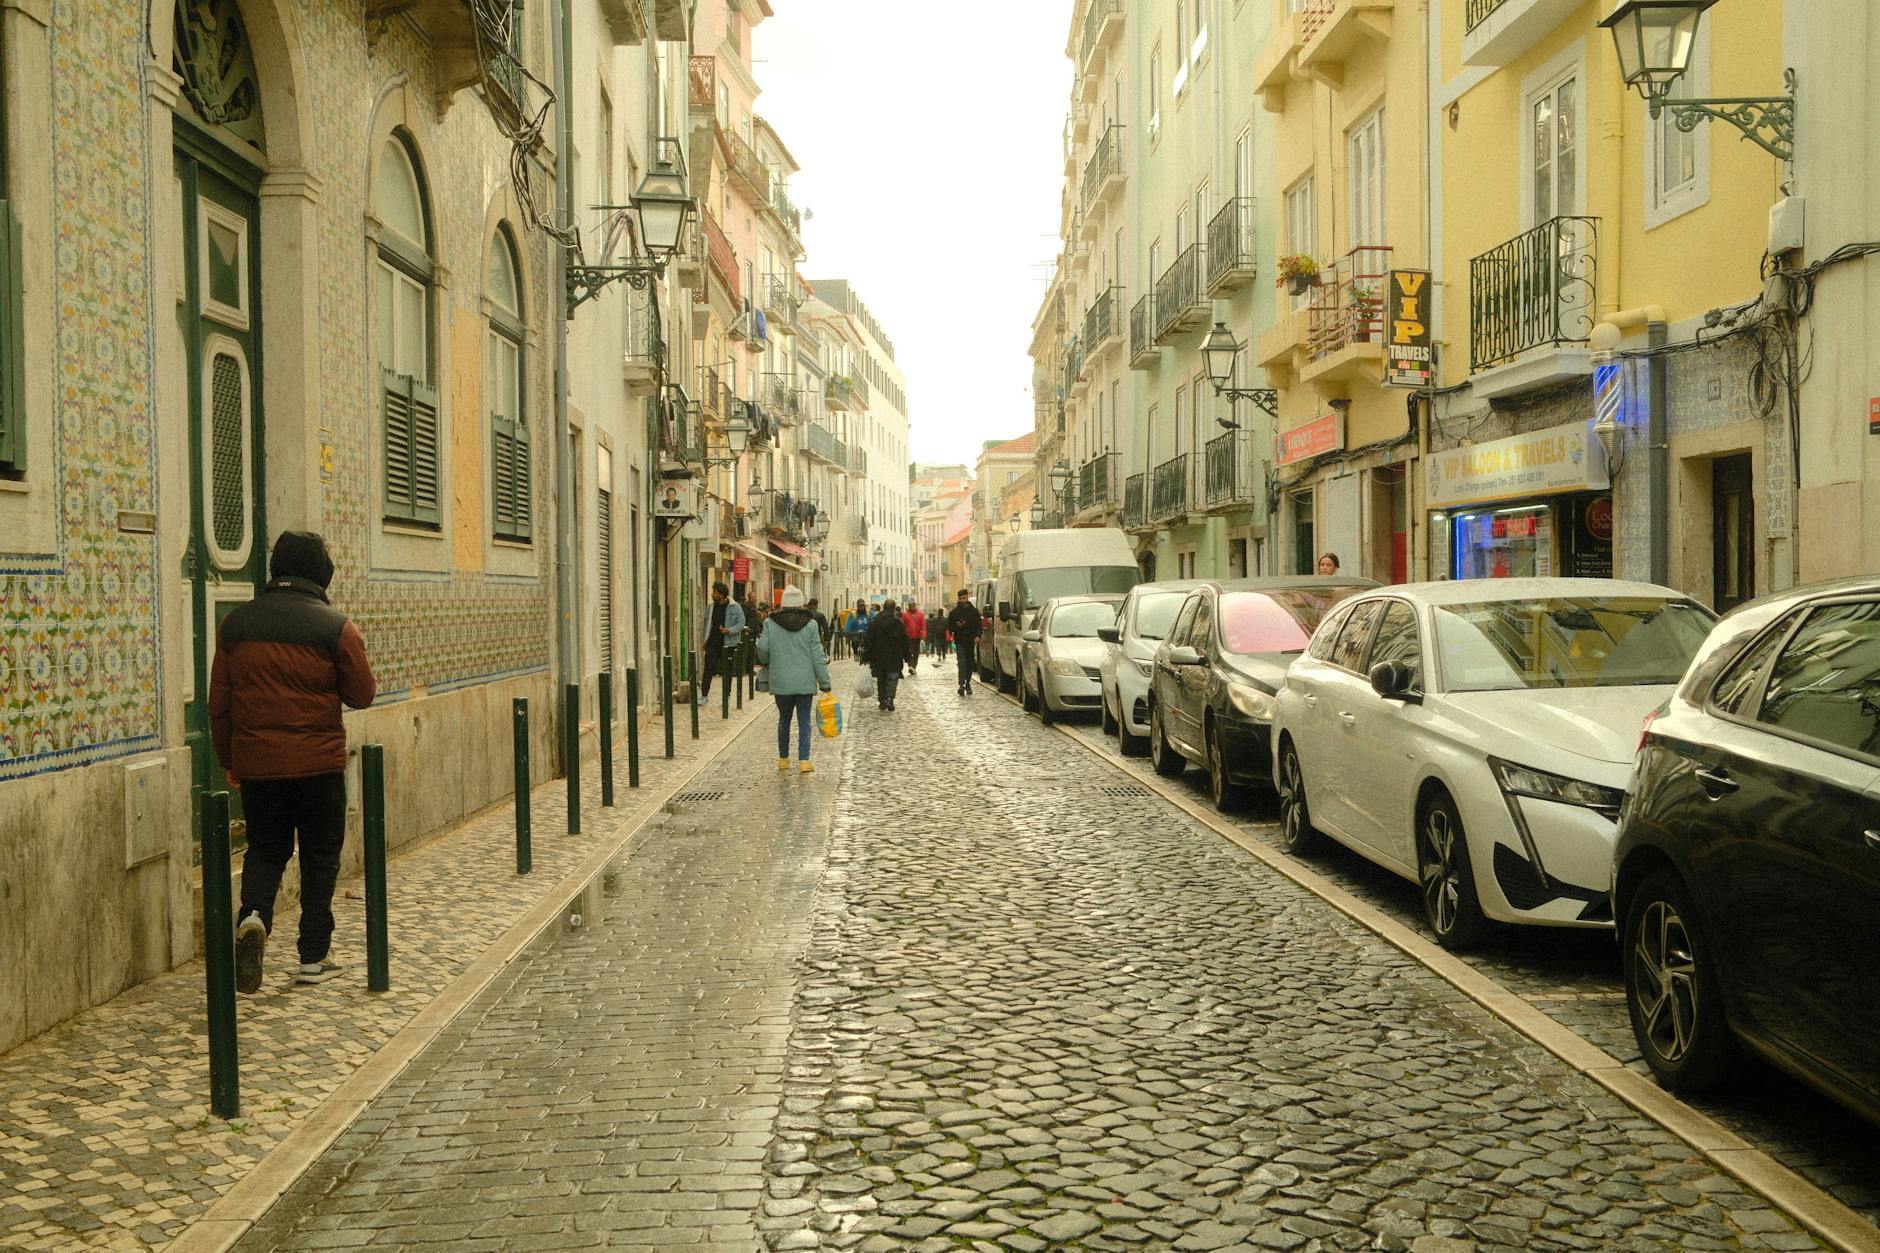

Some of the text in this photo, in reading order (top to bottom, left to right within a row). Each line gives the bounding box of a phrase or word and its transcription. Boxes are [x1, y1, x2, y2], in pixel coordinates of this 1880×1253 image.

[1394, 272, 1425, 343] VIP
[1389, 344, 1429, 361] TRAVELS
[1444, 436, 1566, 480] VIP SALOON & TRAVELS
